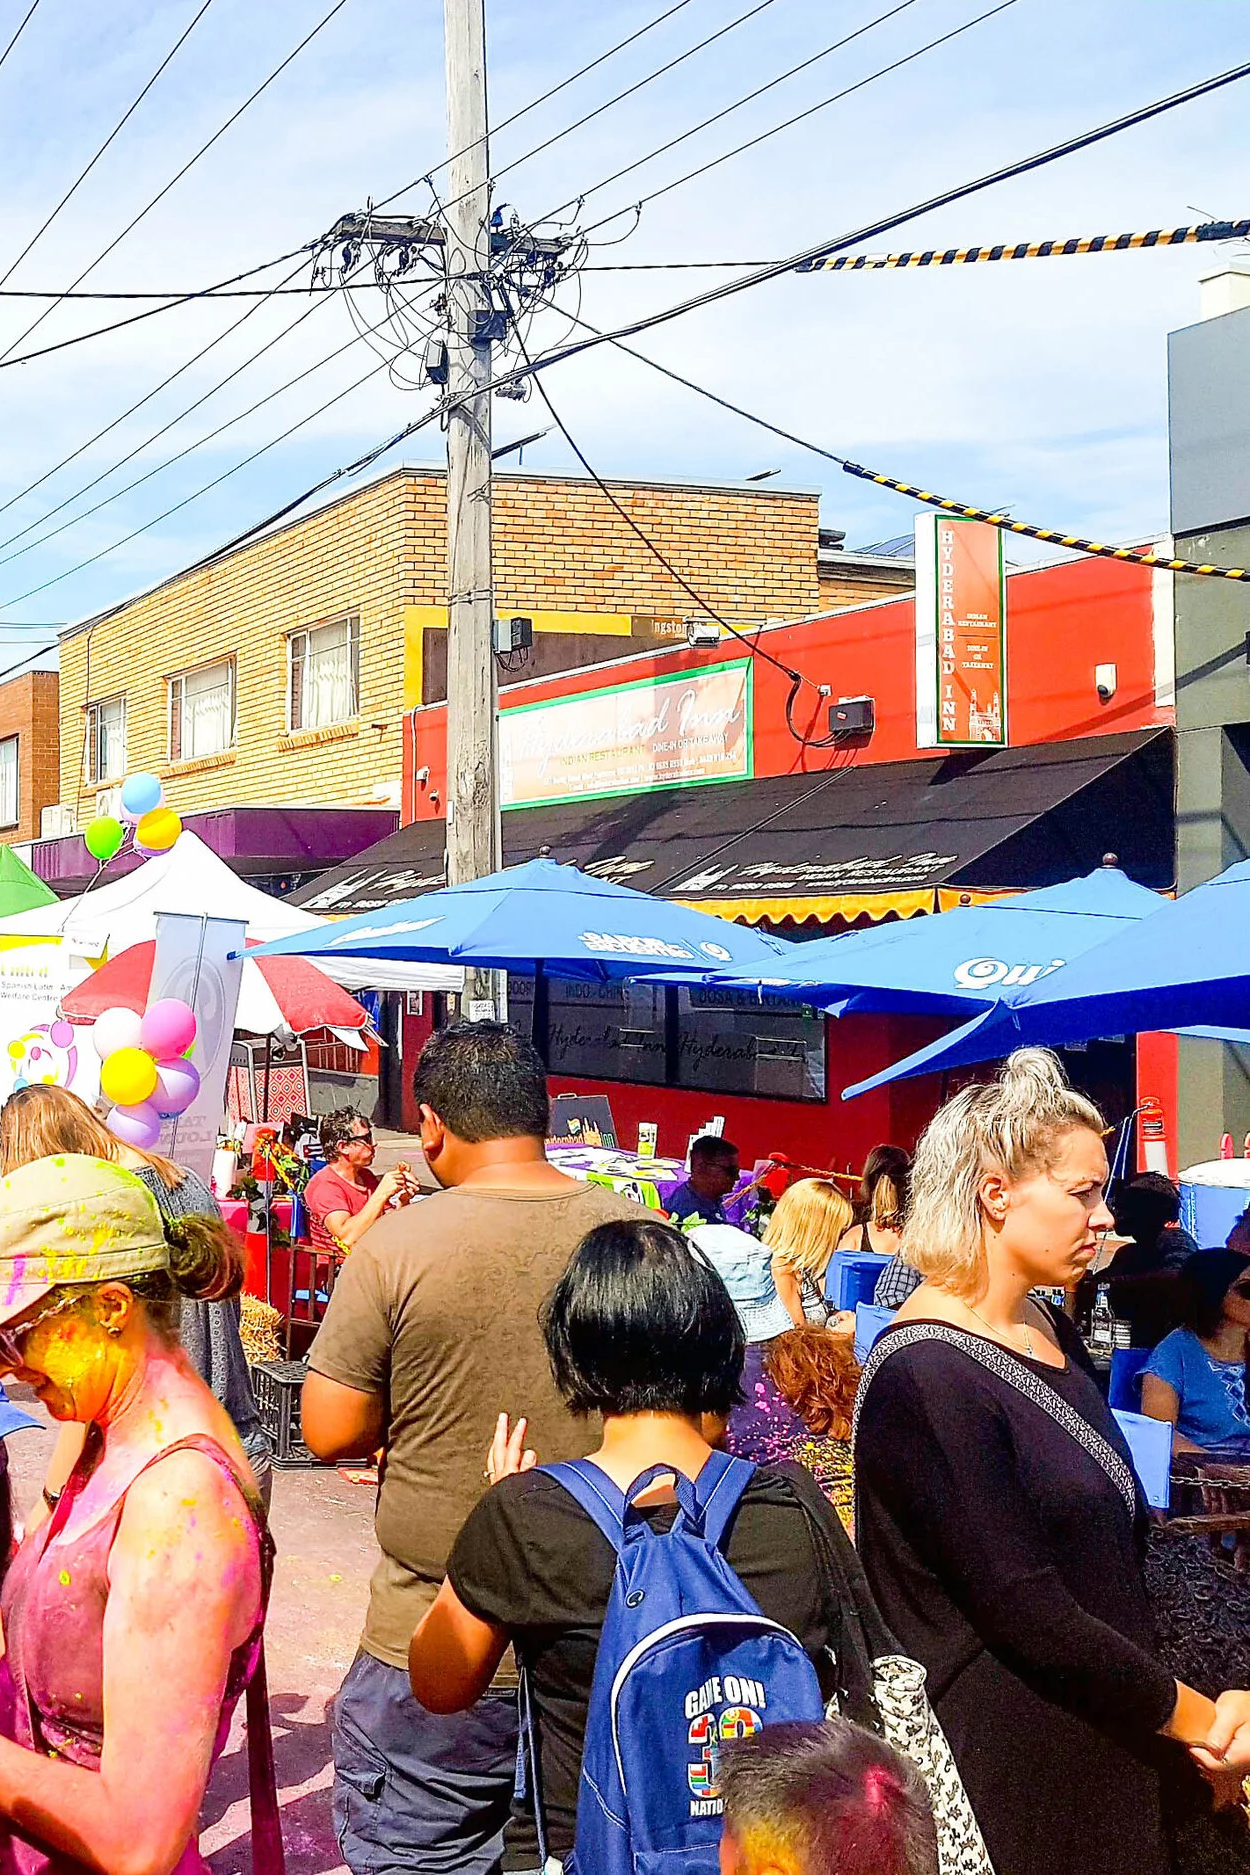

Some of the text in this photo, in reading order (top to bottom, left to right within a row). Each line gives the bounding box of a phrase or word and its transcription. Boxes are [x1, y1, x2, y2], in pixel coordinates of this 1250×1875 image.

[940, 530, 956, 675] HYDERABAD
[676, 688, 740, 737] Inn
[942, 685, 957, 732] INN
[588, 744, 646, 762] RESTAURANT
[684, 1675, 767, 1720] GAME ON!
[689, 1798, 725, 1817] NATIO
